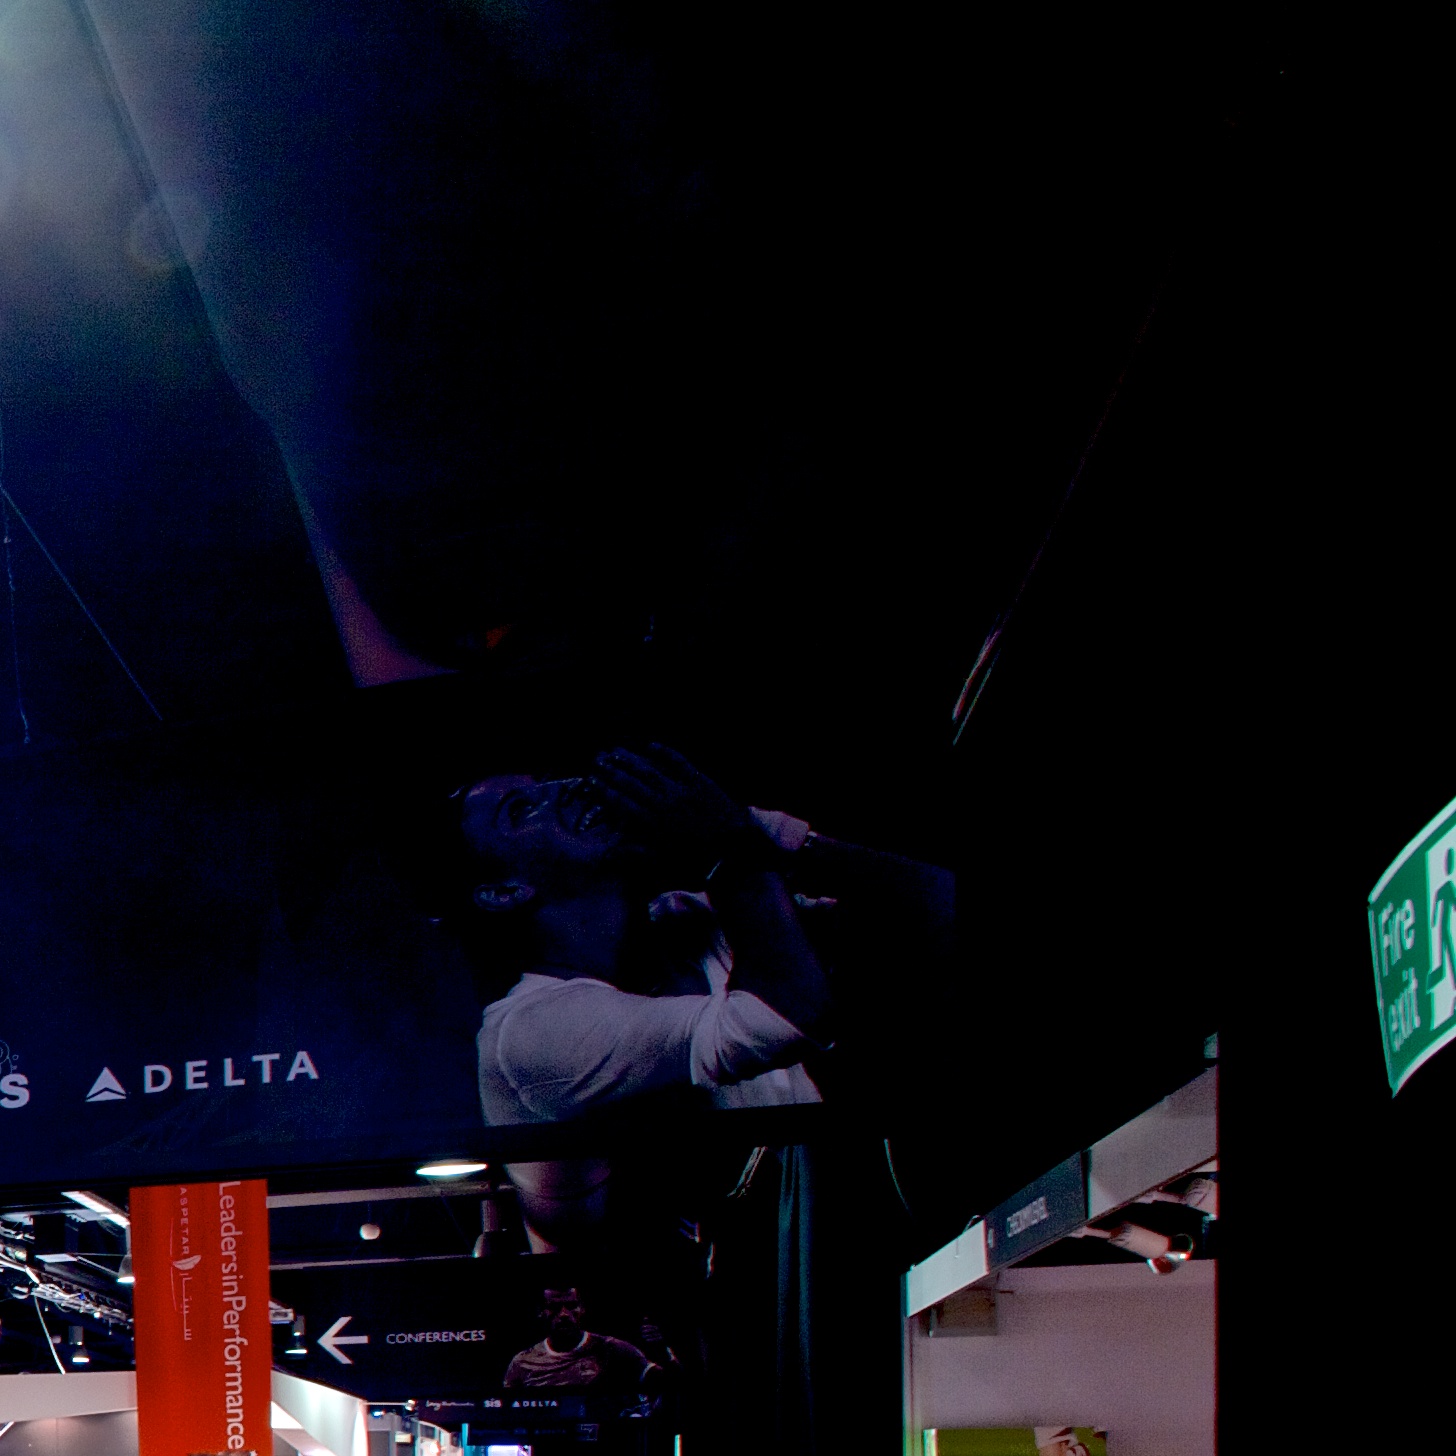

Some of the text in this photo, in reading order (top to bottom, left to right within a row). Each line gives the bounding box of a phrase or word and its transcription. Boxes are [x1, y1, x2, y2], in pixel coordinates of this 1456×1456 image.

[1378, 899, 1416, 977] Fire
[1389, 967, 1421, 1051] exit
[143, 1050, 320, 1094] DELTA
[179, 1187, 190, 1255] ASPETAR
[386, 1330, 485, 1344] CONFERENCES
